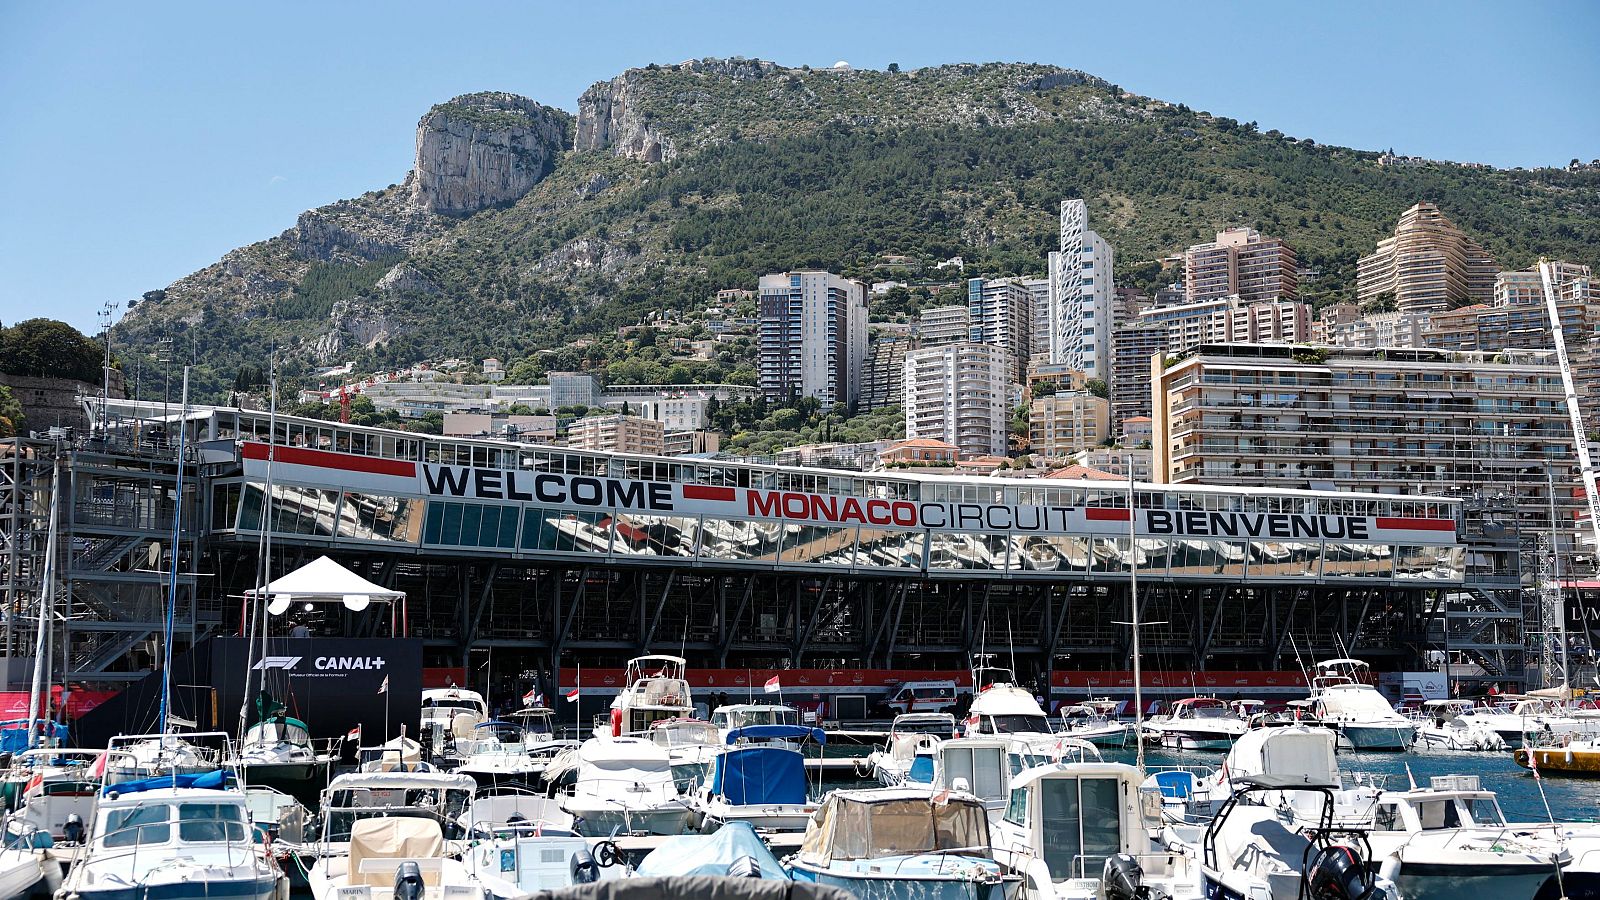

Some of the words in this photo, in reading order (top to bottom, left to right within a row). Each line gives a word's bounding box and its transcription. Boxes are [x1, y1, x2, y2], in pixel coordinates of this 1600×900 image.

[422, 463, 674, 512] WELCOME
[1147, 509, 1369, 539] BIENVENUE
[315, 656, 386, 670] CANAL+
